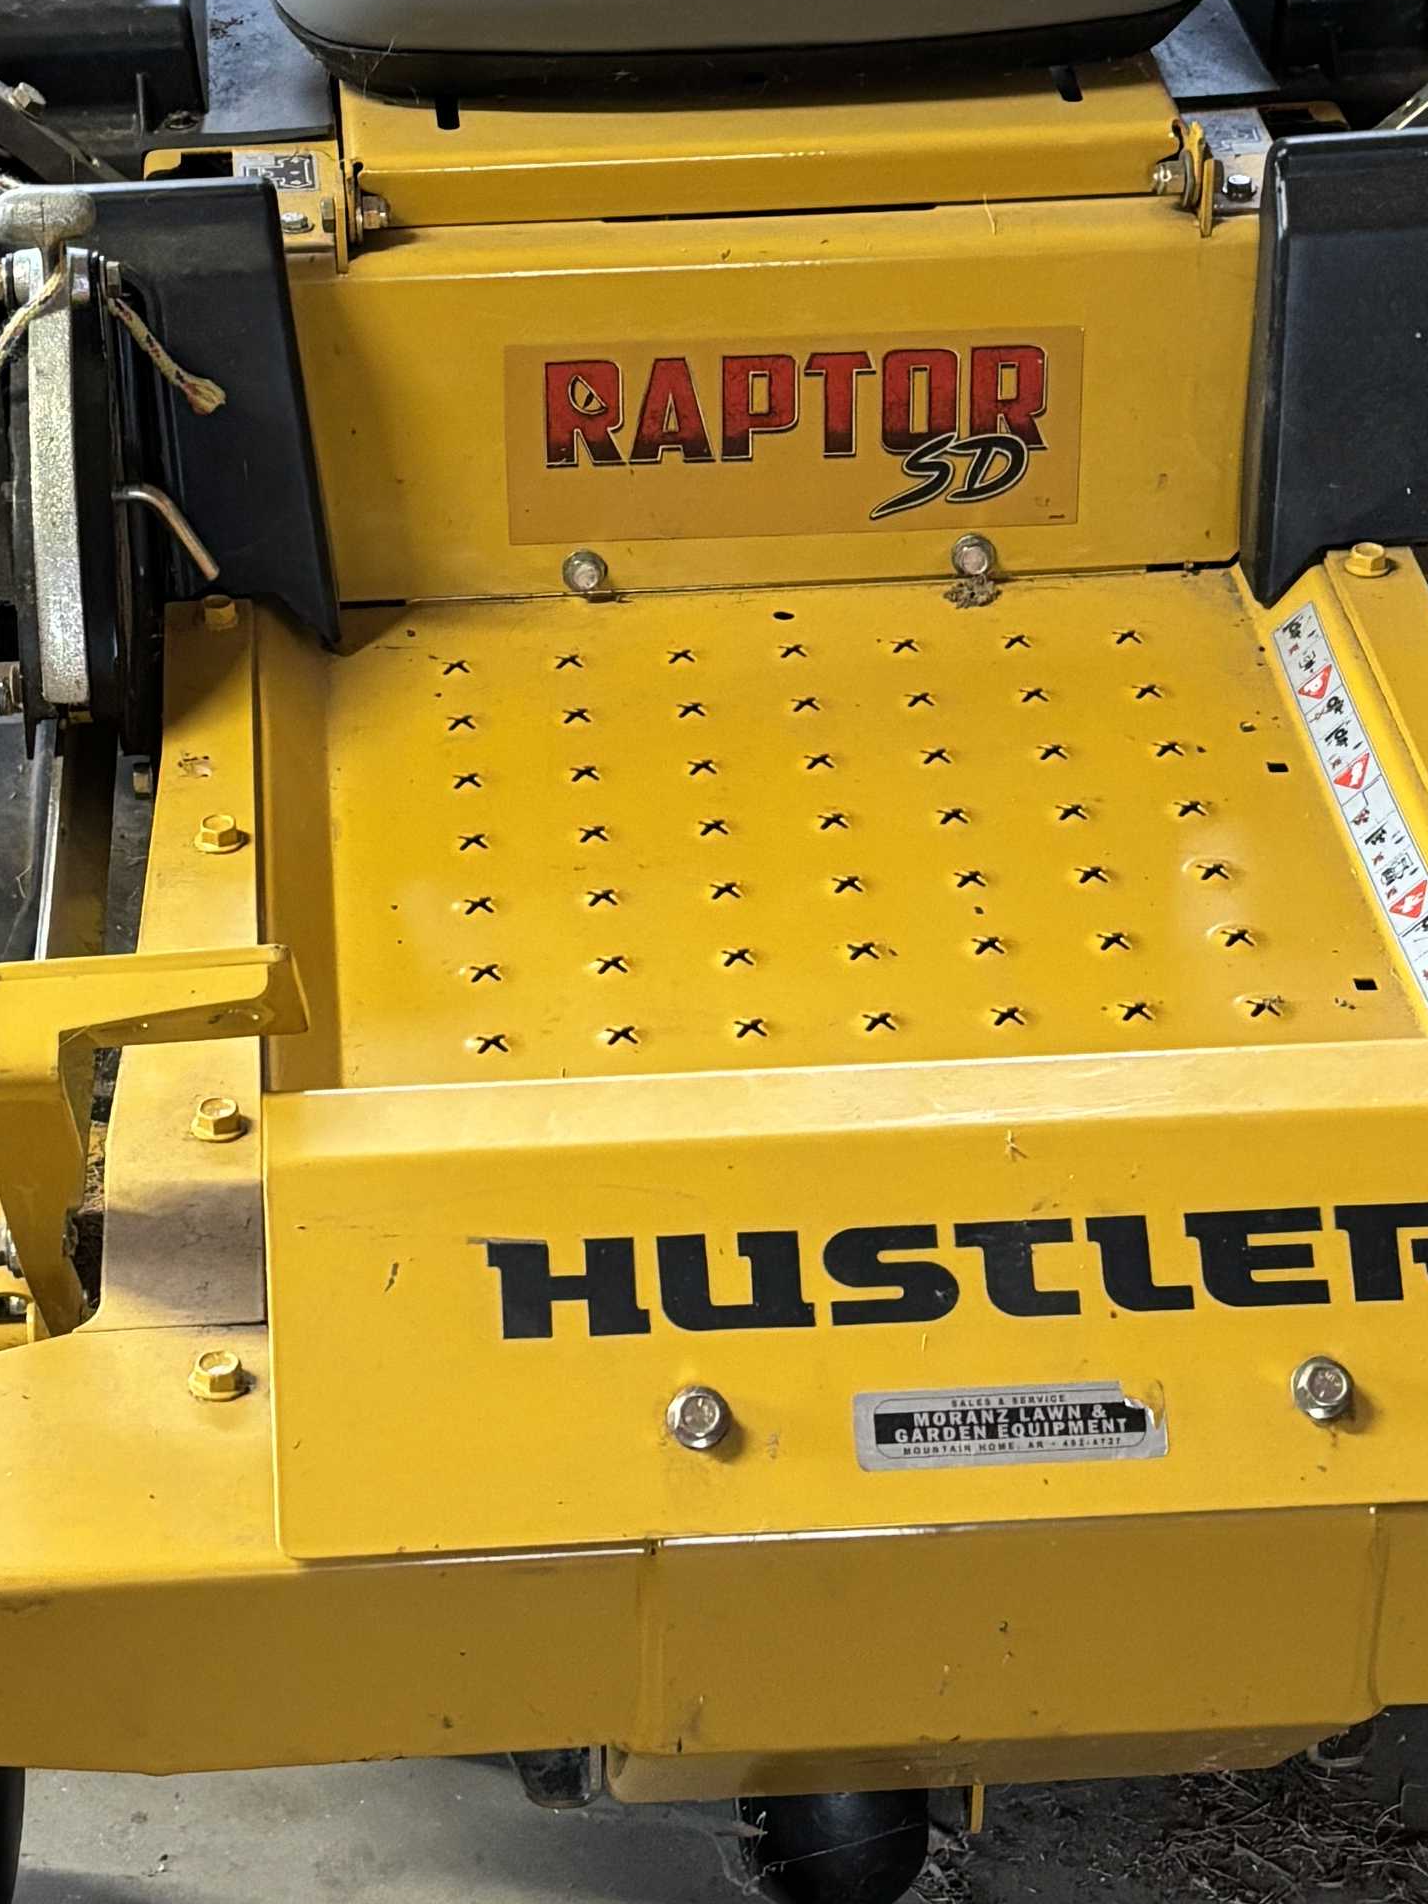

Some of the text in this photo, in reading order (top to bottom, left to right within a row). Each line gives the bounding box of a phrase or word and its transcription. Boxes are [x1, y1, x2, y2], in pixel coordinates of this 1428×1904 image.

[545, 345, 1050, 467] RAPTOR
[870, 432, 1028, 520] SD
[951, 1397, 991, 1408] SALES
[1012, 1394, 1066, 1406] SERVICE
[913, 1404, 1107, 1427] MORANZ LAWN &
[894, 1418, 1127, 1443] GARDEN EQUIPMENT
[903, 1442, 972, 1456] MOUNTAIN
